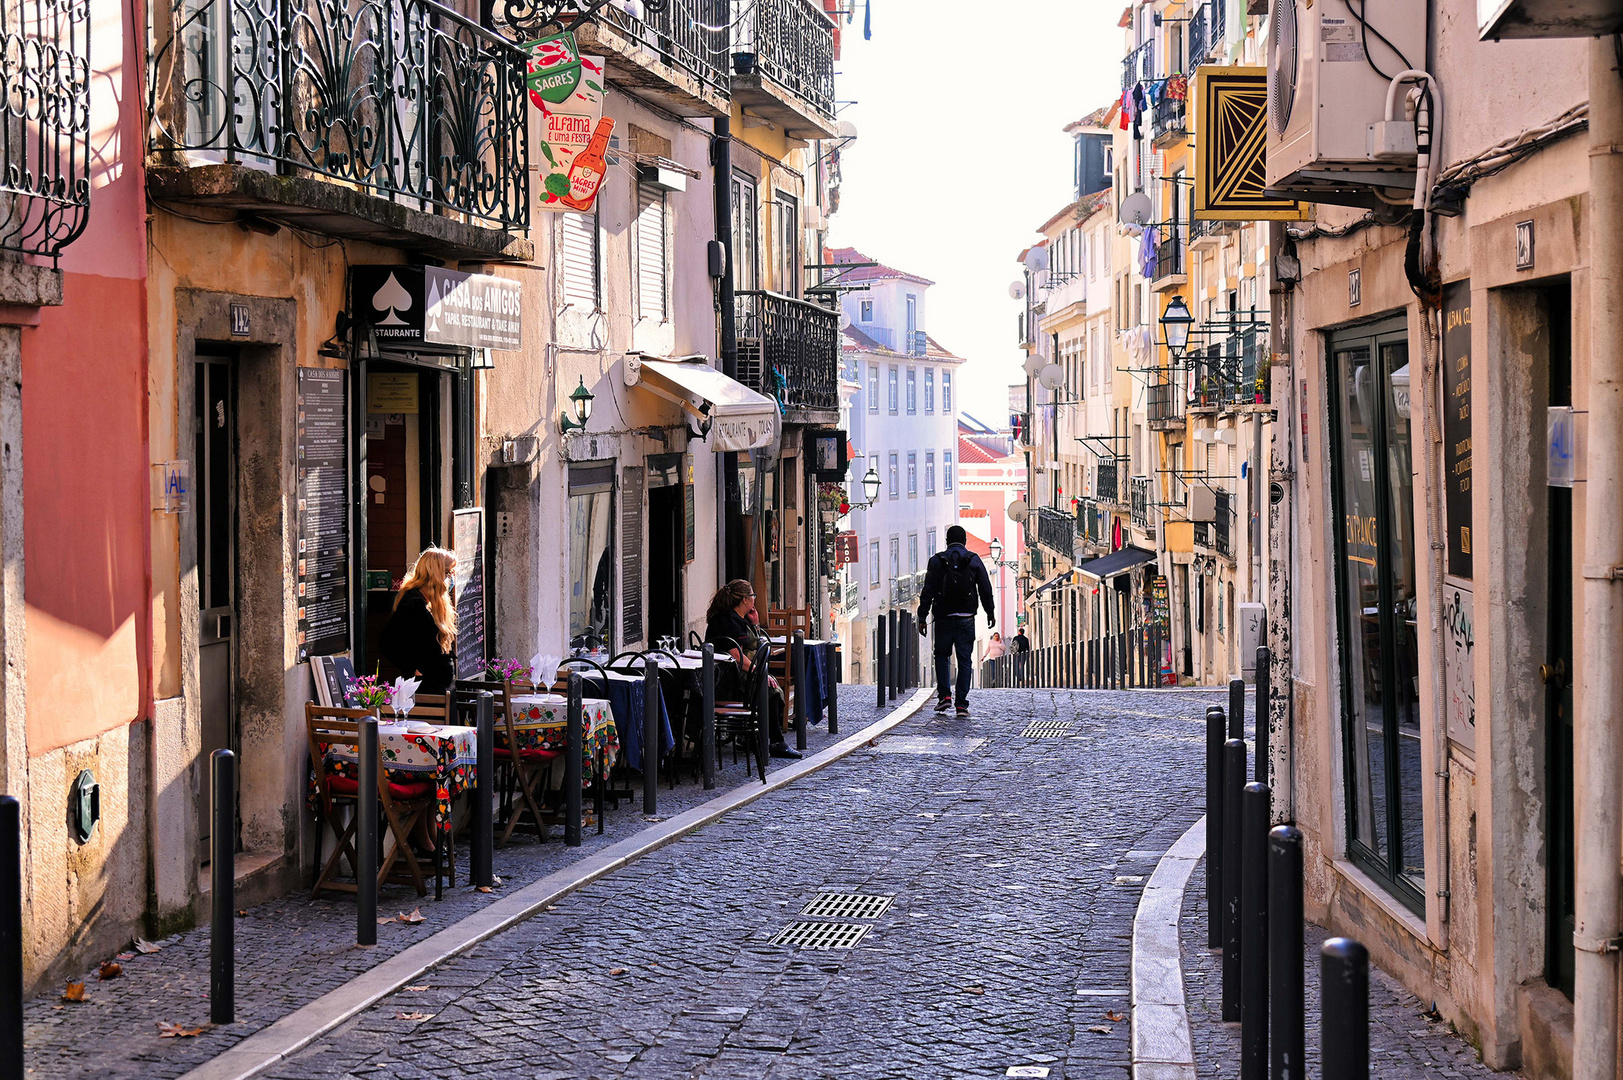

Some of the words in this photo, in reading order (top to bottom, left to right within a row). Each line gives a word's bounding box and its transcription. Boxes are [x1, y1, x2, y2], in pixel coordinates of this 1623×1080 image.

[535, 71, 574, 93] SAGRES
[571, 175, 596, 190] SAGRES
[1516, 226, 1530, 265] 129
[443, 278, 471, 309] CASA
[484, 286, 521, 317] AMIGOS
[234, 307, 249, 332] 142
[461, 314, 491, 330] RESTAURANT
[496, 318, 507, 331] TAKE
[375, 328, 420, 337] STAURANTE
[1550, 422, 1569, 459] AL
[169, 469, 186, 494] AL
[1346, 514, 1378, 547] ENTRANCE
